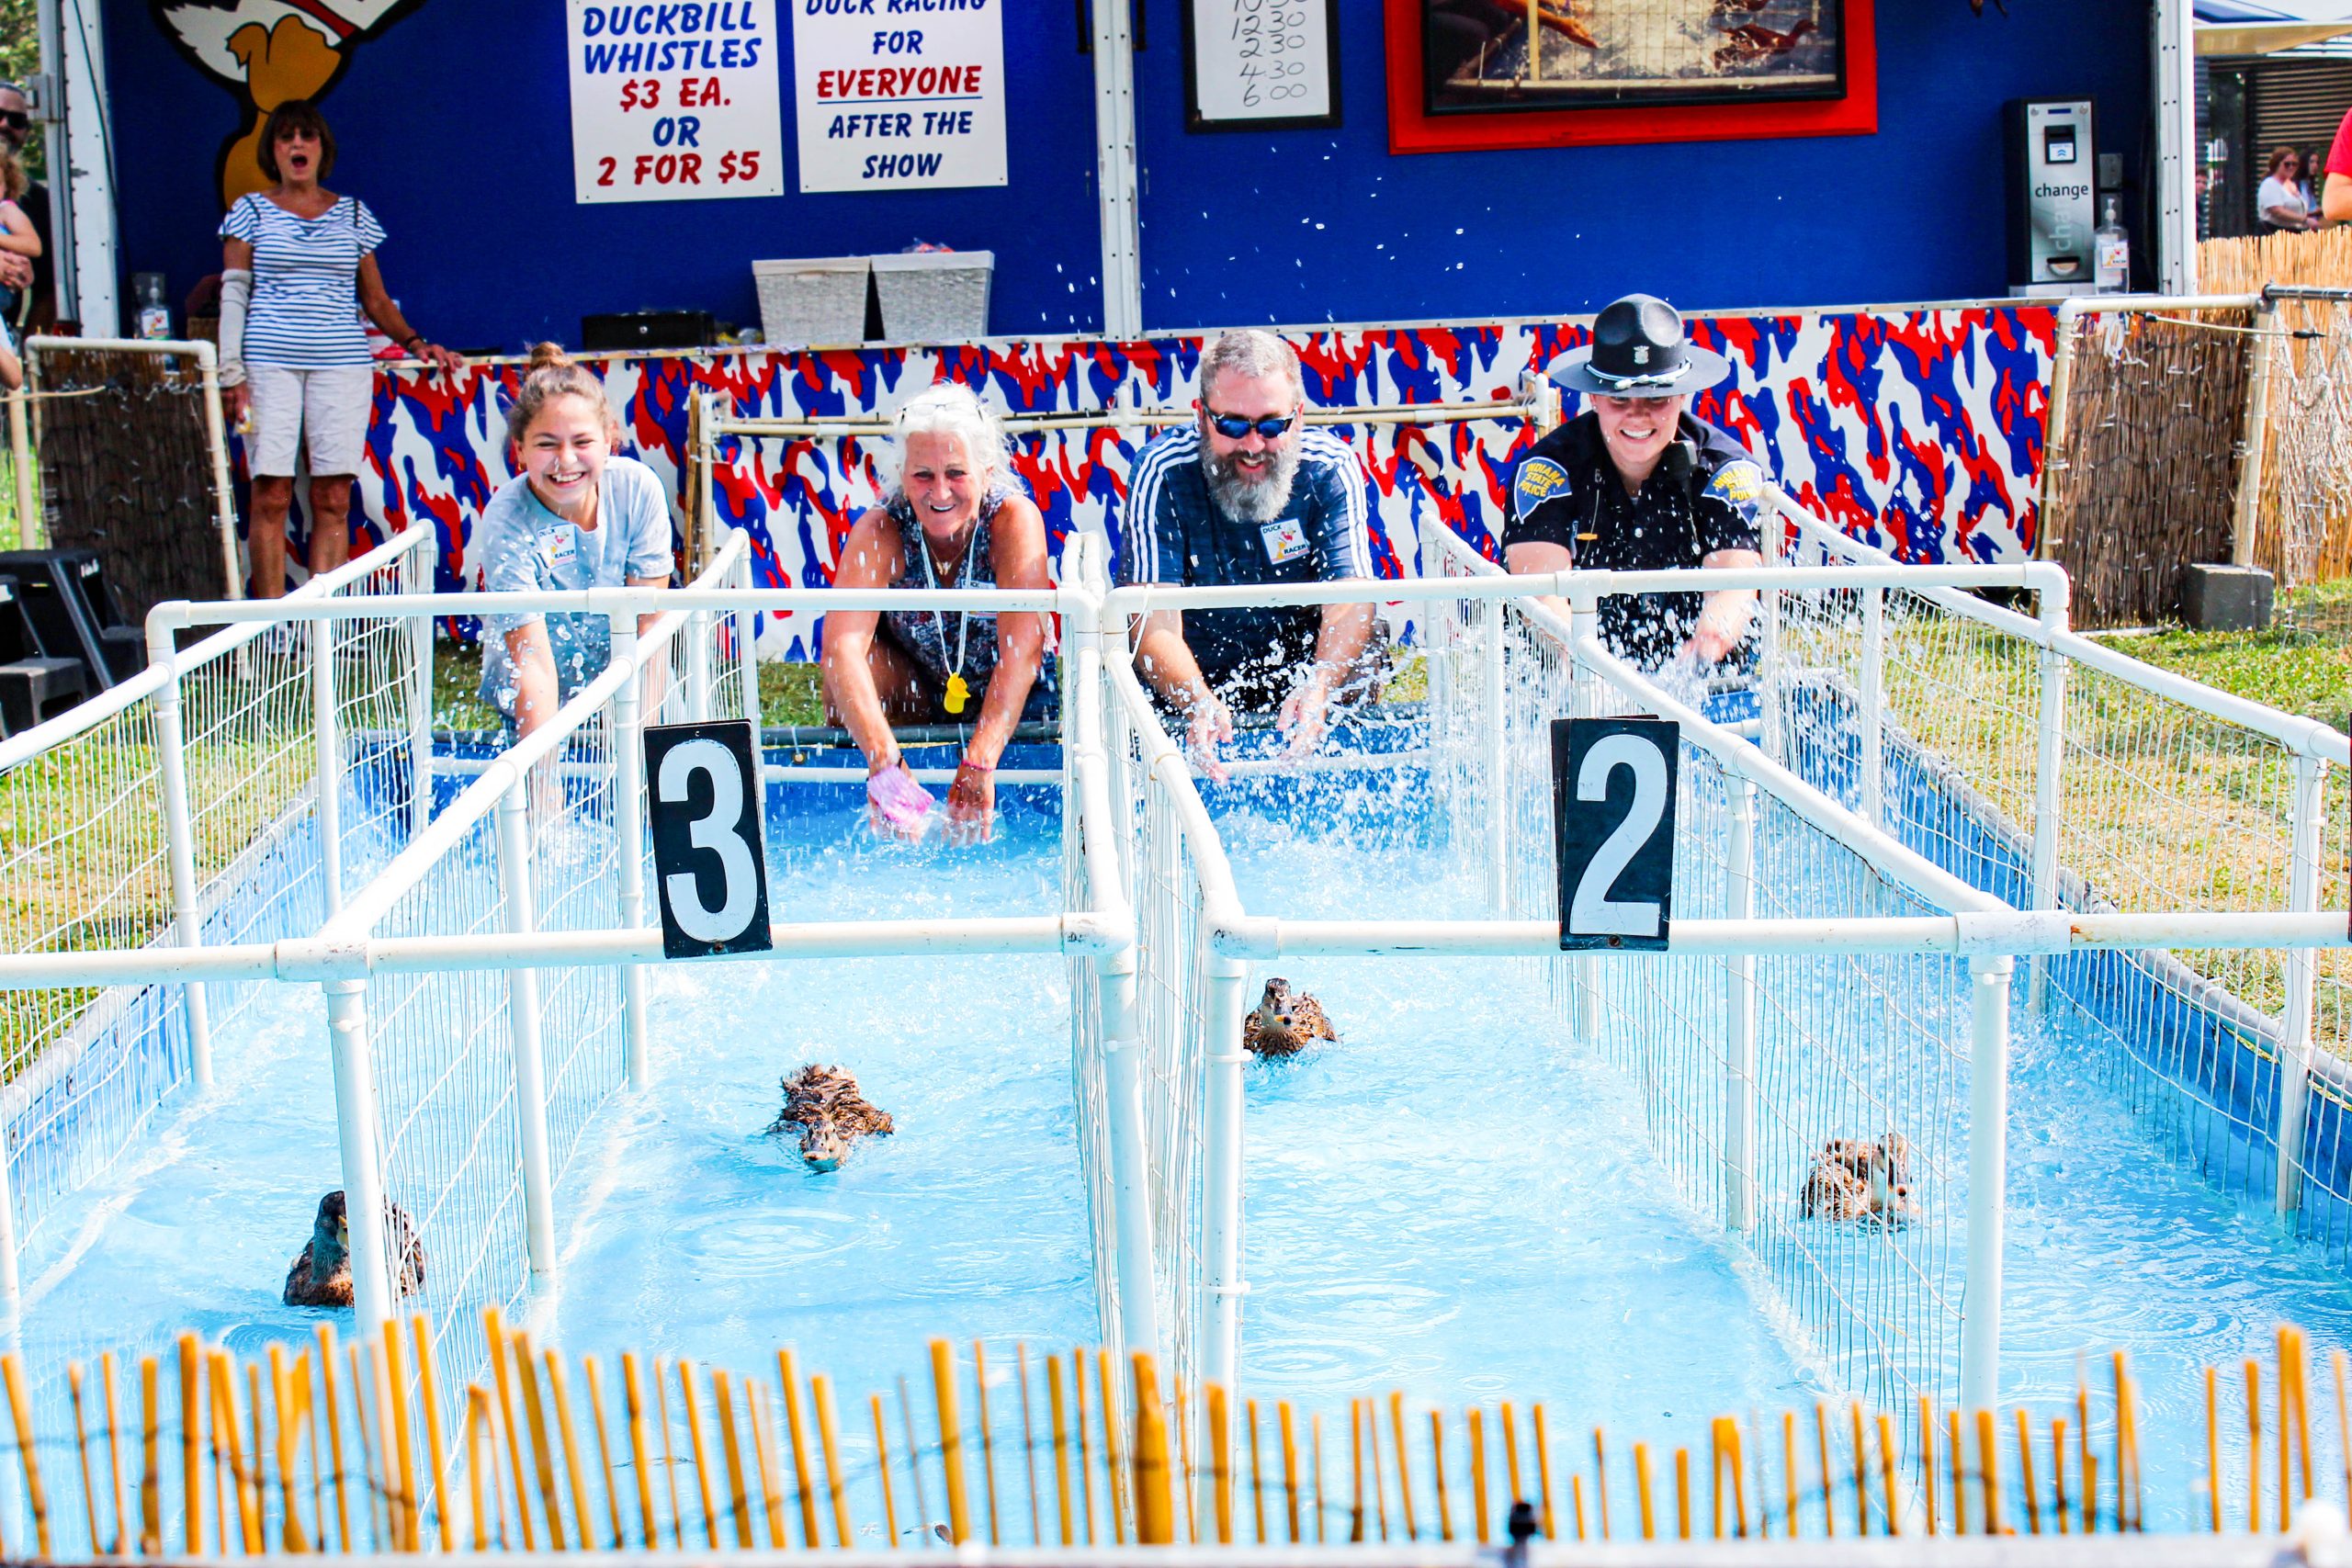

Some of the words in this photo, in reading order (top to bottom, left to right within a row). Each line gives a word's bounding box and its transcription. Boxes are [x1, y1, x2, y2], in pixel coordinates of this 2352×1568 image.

[583, 1, 756, 37] DUCKBILL
[584, 38, 762, 73] WHISTLES
[873, 30, 923, 55] FOR
[619, 79, 661, 112] $3
[679, 76, 731, 107] EA.
[818, 66, 982, 98] EVERYONE
[653, 116, 700, 148] OR
[829, 113, 912, 138] AFTER
[922, 111, 973, 136] THE
[597, 156, 616, 186] 2
[634, 152, 702, 185] FOR
[718, 151, 760, 184] $5
[863, 153, 943, 178] SHOW
[2035, 183, 2088, 200] change
[1525, 471, 1553, 489] STATE
[1526, 463, 1566, 488] INDIANA
[1262, 525, 1281, 533] DUCK
[1283, 544, 1306, 554] RACER
[659, 739, 757, 943] 3
[1569, 734, 1668, 936] 2
